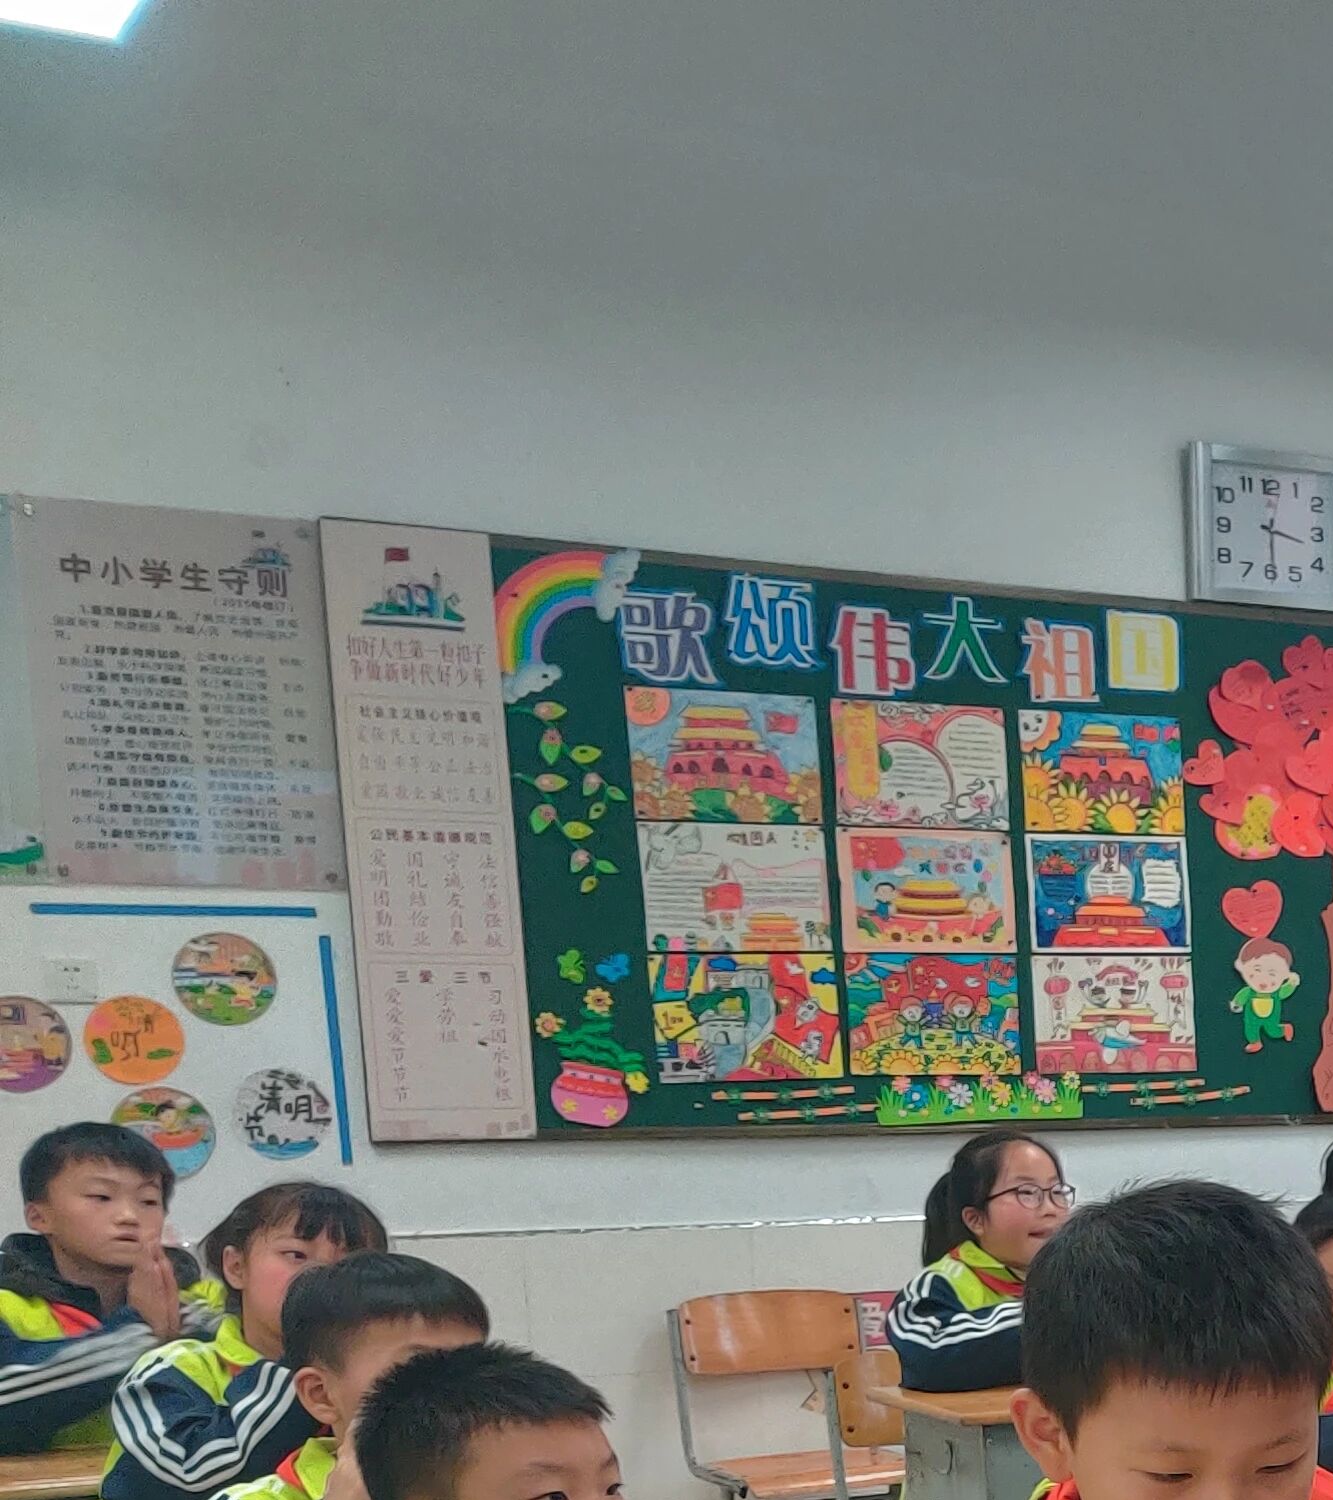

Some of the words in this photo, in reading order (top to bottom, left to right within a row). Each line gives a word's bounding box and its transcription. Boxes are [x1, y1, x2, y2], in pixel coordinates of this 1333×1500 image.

[1240, 475, 1253, 493] 11
[1261, 478, 1280, 496] 12
[1292, 482, 1299, 499] 1
[1215, 486, 1235, 504] 10
[1310, 496, 1324, 513] 2
[1216, 516, 1231, 533] 9
[1310, 527, 1324, 542] 3
[1217, 547, 1231, 564] 8
[1239, 561, 1254, 578] 7
[1264, 563, 1278, 580] 6
[1310, 557, 1324, 573] 4
[59, 552, 289, 598] 中小学生守则
[1288, 566, 1302, 582] 5
[620, 573, 1182, 701] 歌颂伟大祖国
